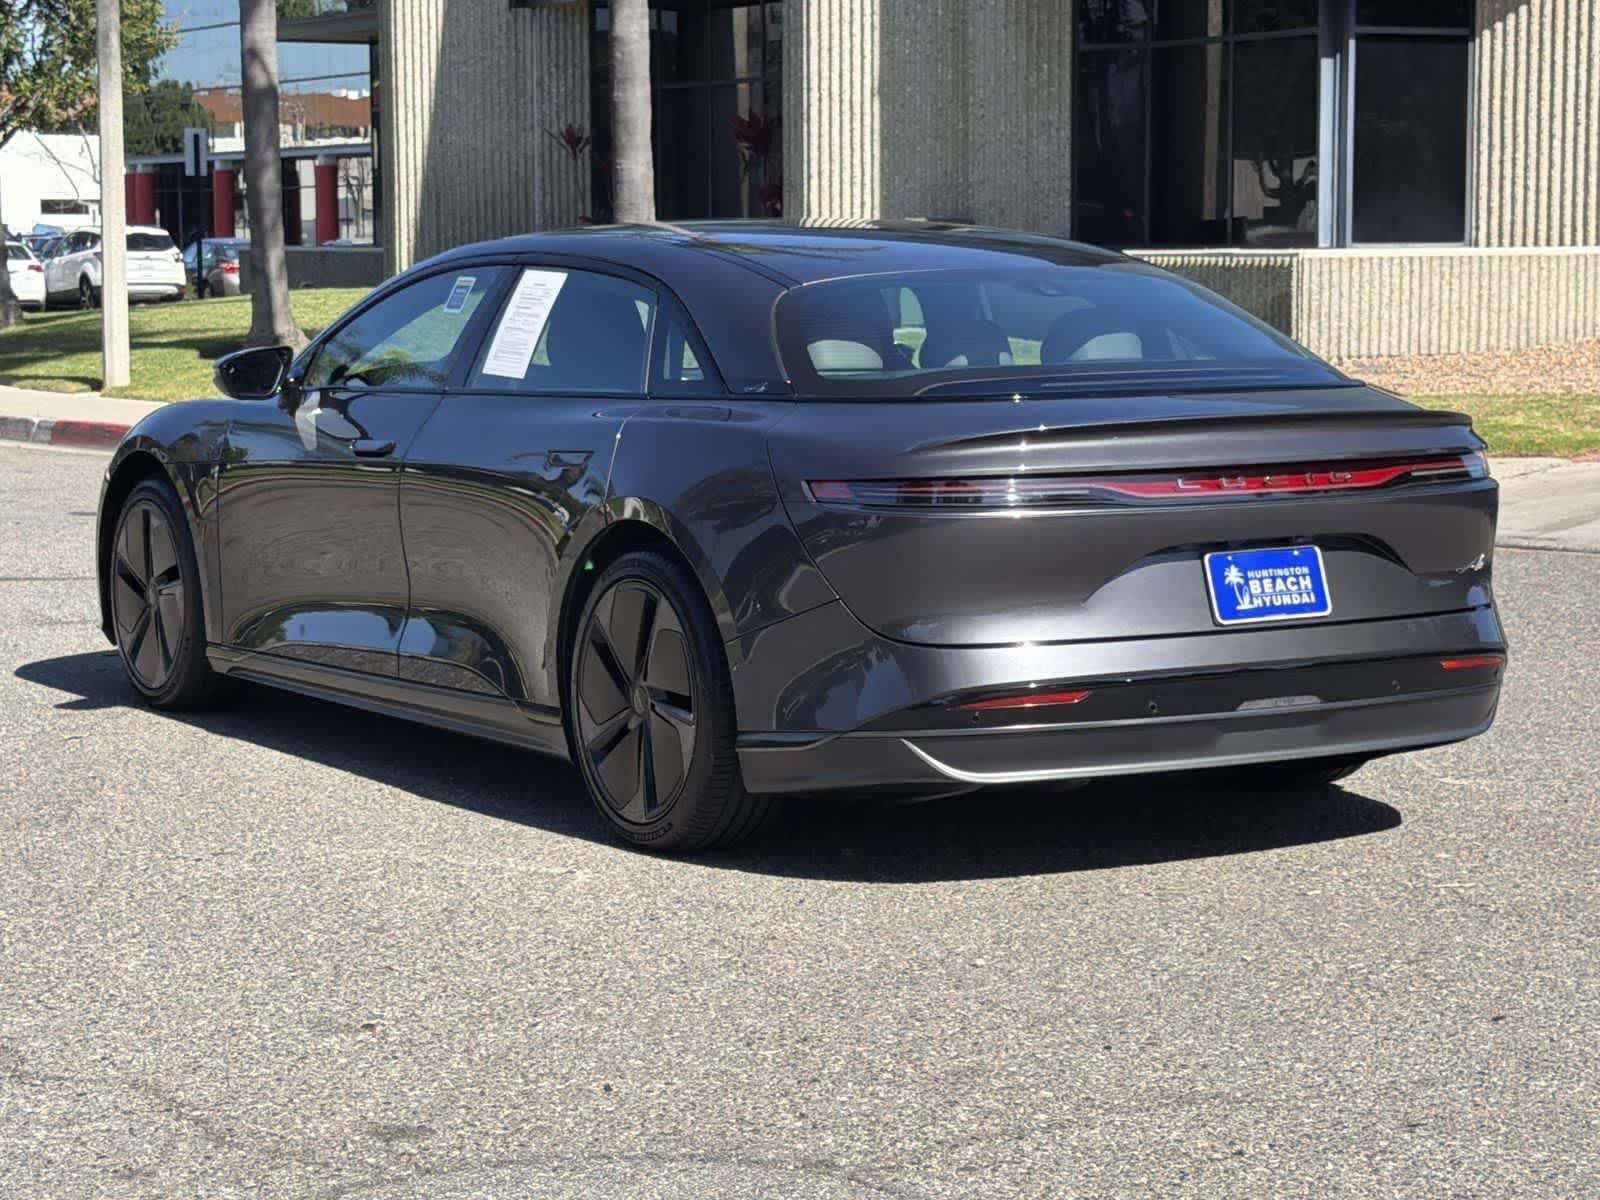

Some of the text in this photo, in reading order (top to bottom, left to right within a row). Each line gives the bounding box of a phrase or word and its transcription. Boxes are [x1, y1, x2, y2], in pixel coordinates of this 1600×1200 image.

[1247, 566, 1310, 578] HUNTINGTON
[1249, 575, 1313, 594] BEACH
[1253, 592, 1316, 608] HYUNDAI
